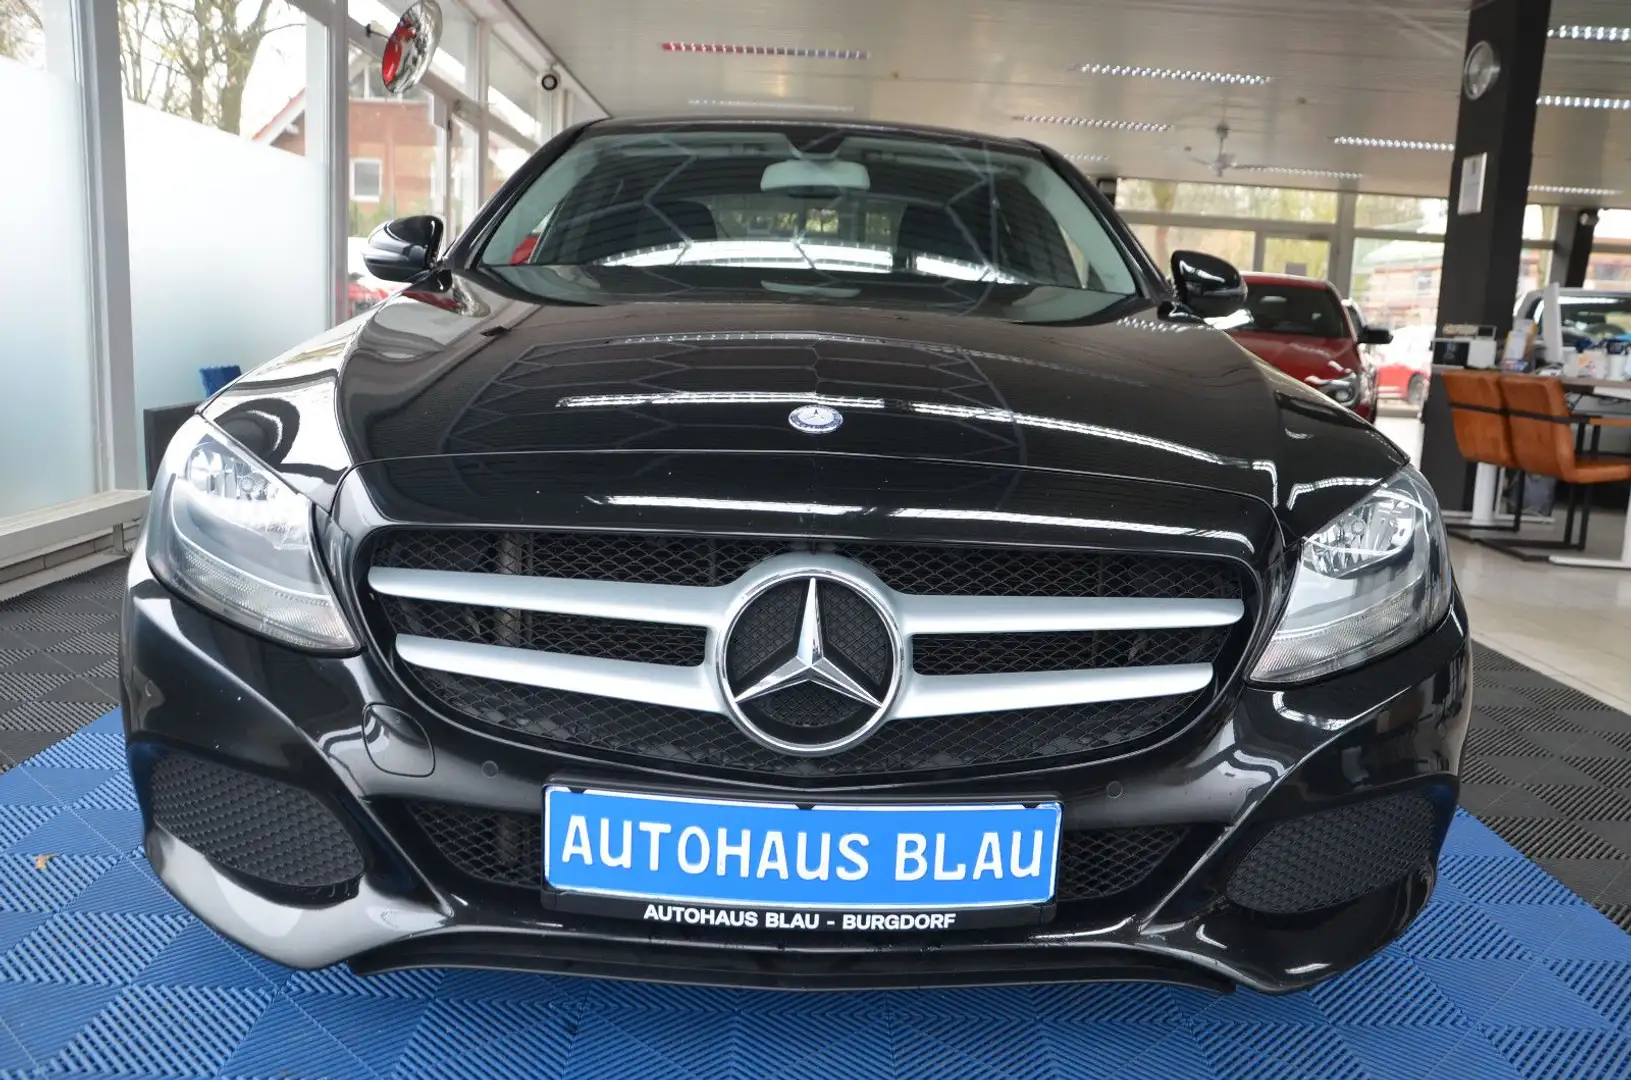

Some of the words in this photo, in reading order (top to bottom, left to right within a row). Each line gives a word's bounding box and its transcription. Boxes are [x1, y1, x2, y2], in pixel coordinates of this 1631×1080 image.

[561, 815, 870, 881] AUTOHAUS
[895, 829, 1044, 881] BLAU
[643, 904, 759, 927] AUTOHAUS
[765, 911, 820, 930] BLAU
[842, 913, 957, 930] BURGDORF
